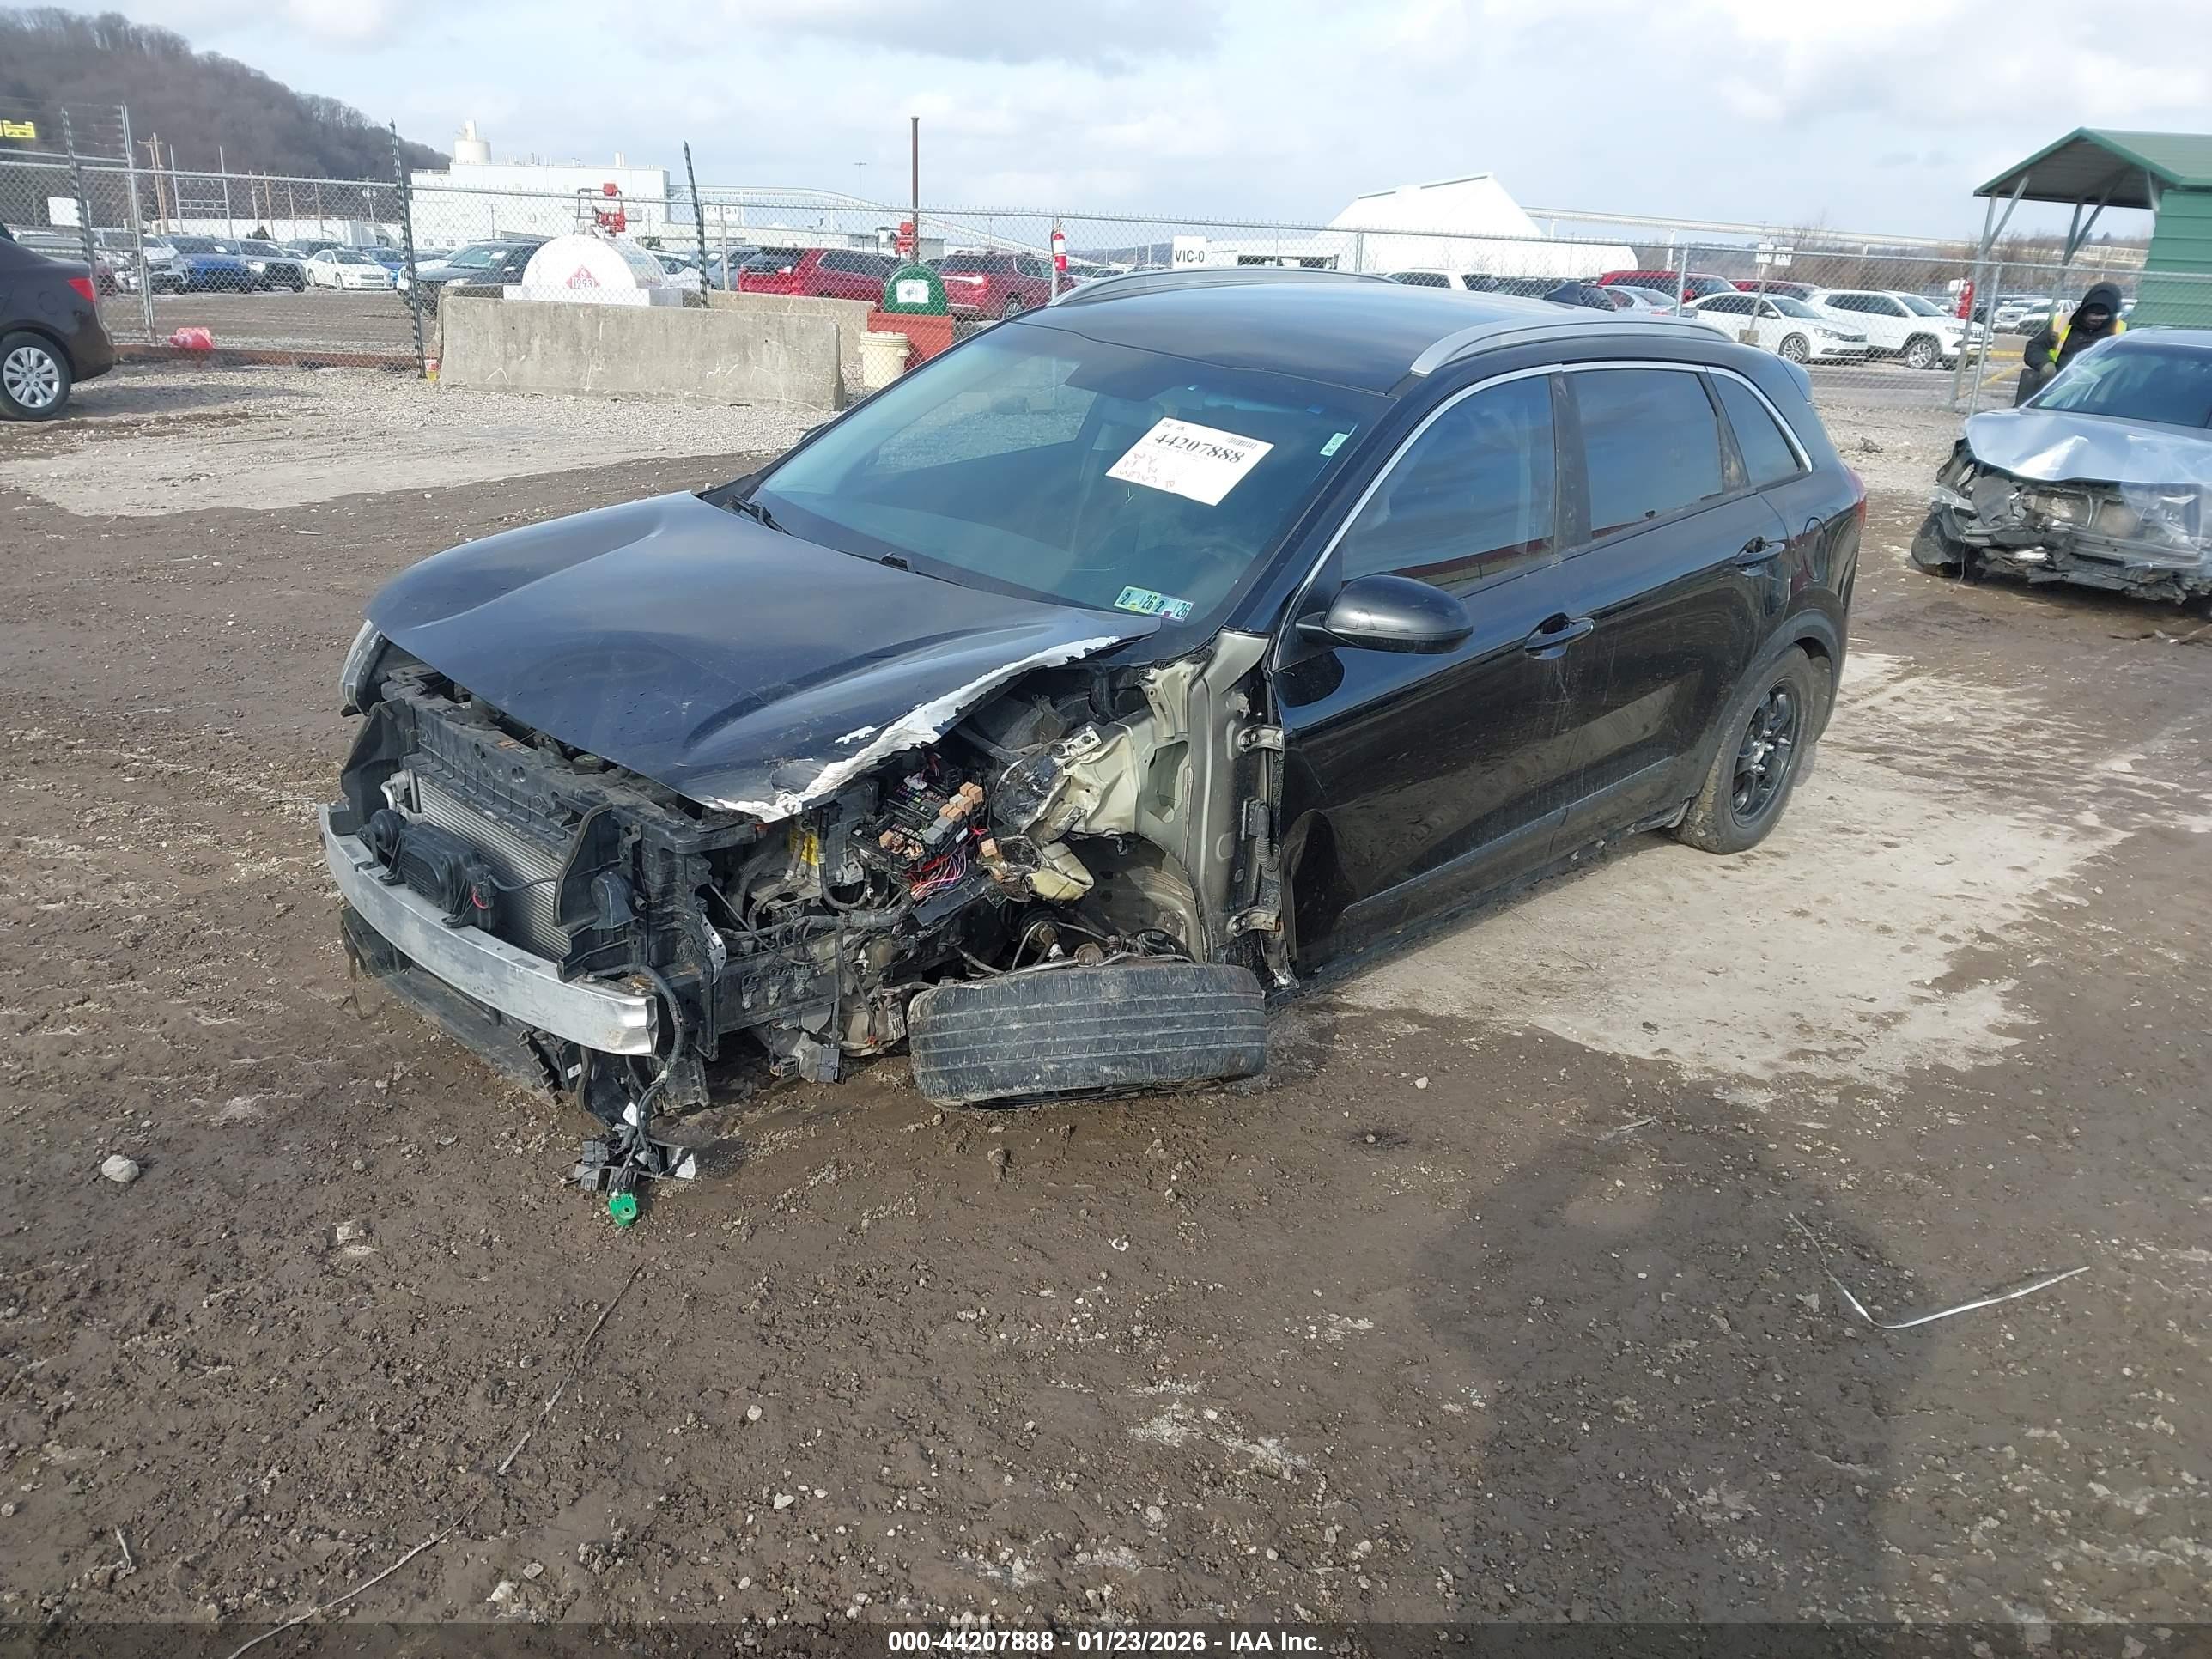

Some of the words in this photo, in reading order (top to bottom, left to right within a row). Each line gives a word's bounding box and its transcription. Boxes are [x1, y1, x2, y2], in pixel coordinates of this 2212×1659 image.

[574, 278, 592, 289] 1993
[1155, 433, 1245, 464] 44207888
[1176, 602, 1192, 617] 26
